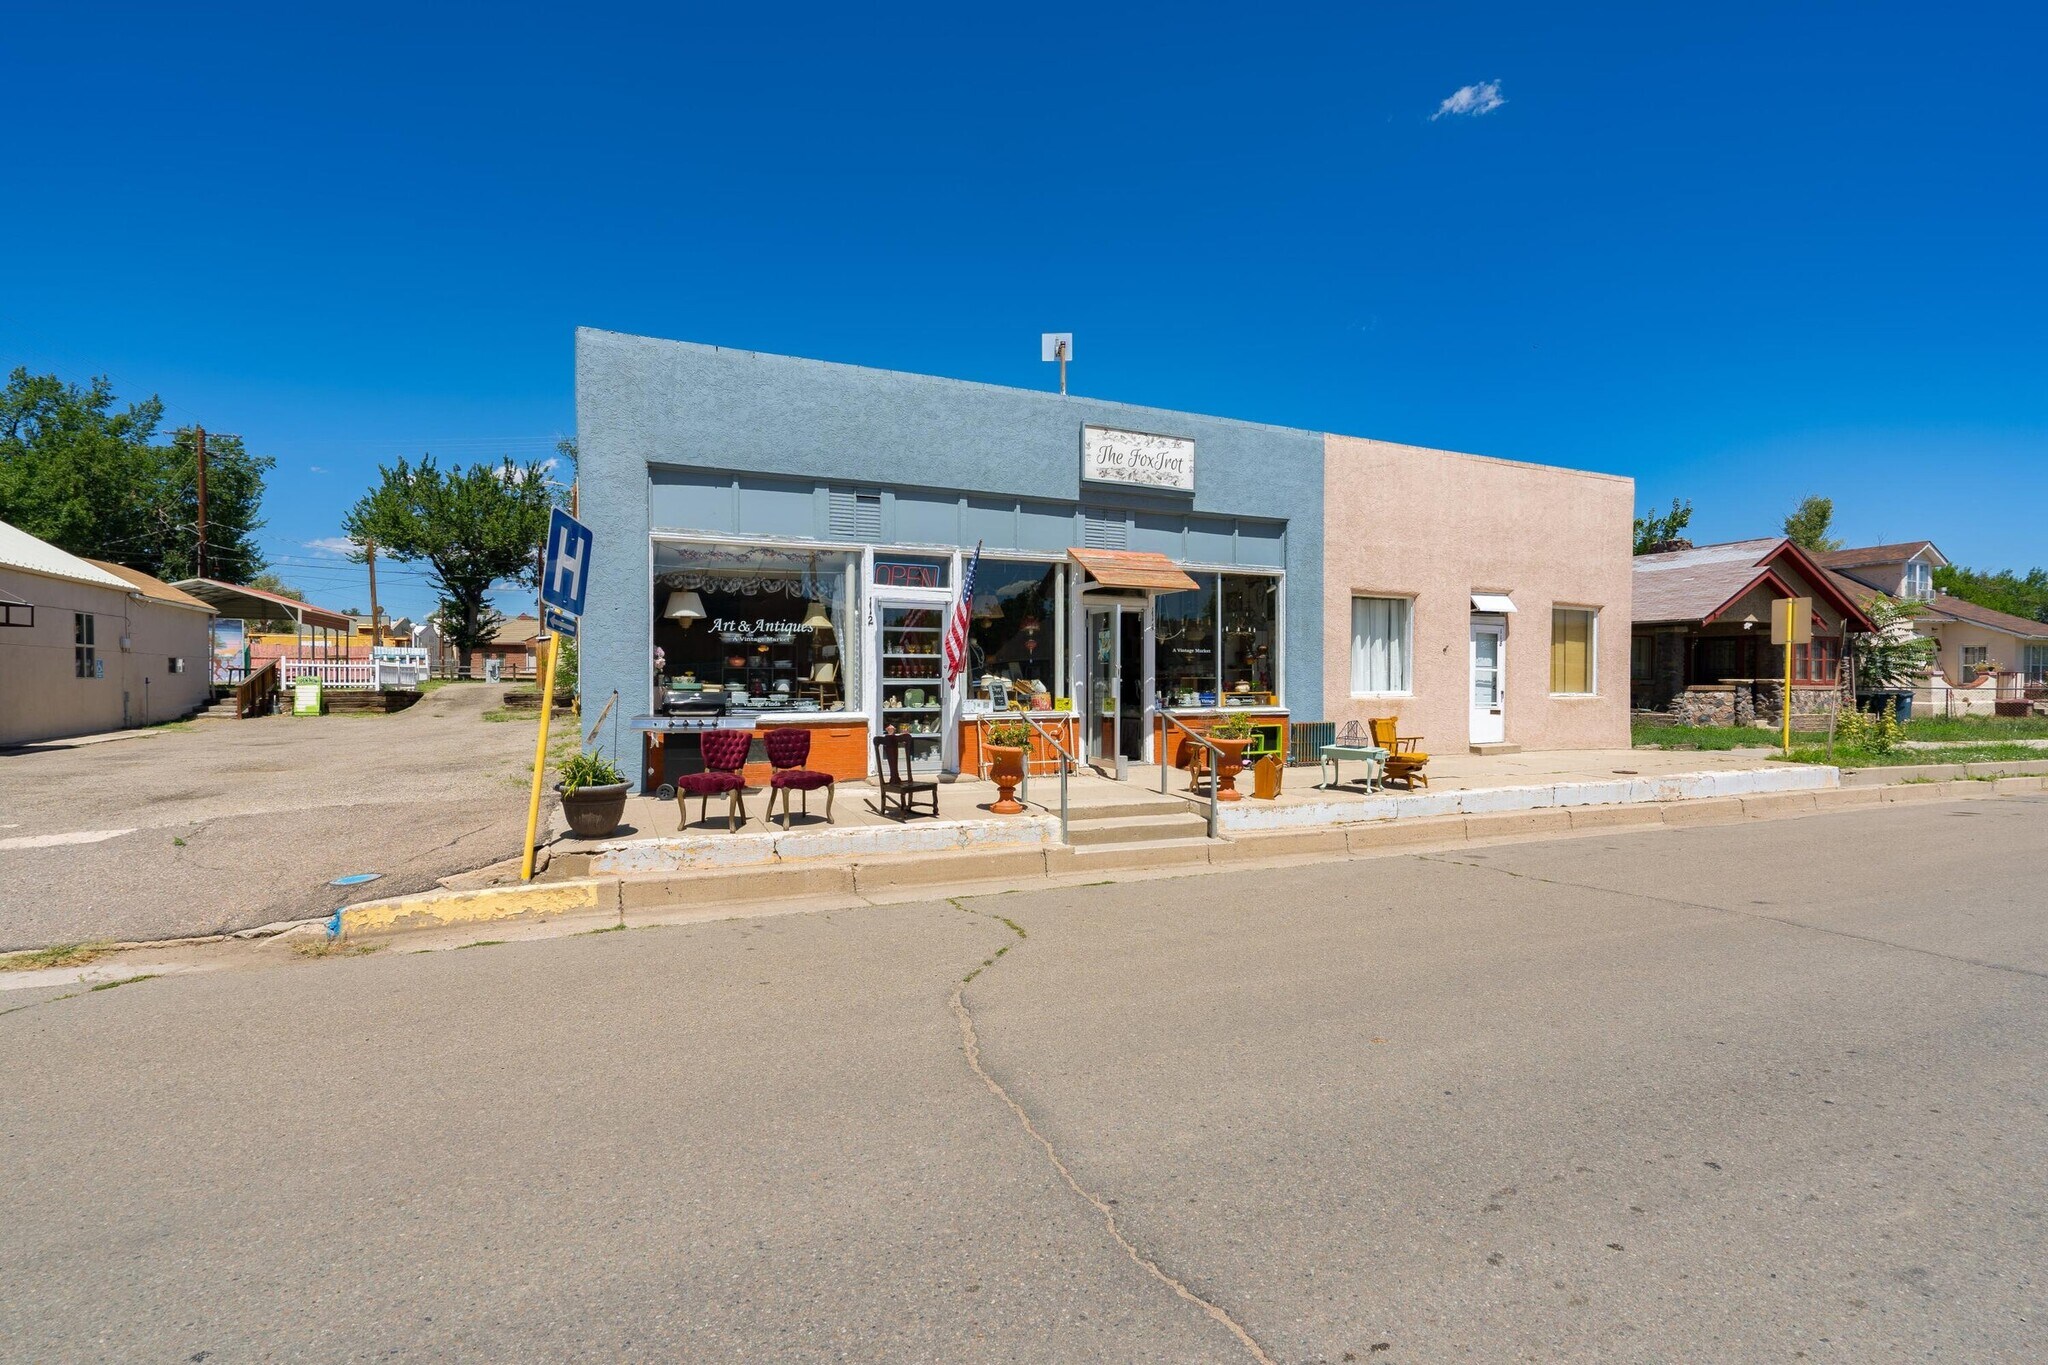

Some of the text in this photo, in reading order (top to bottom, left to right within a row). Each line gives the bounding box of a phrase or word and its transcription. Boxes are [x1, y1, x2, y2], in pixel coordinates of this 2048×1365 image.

[1097, 445, 1183, 473] The FoxTrot
[553, 526, 585, 600] H
[876, 565, 938, 587] OPEN
[708, 618, 814, 636] Art & Antiques
